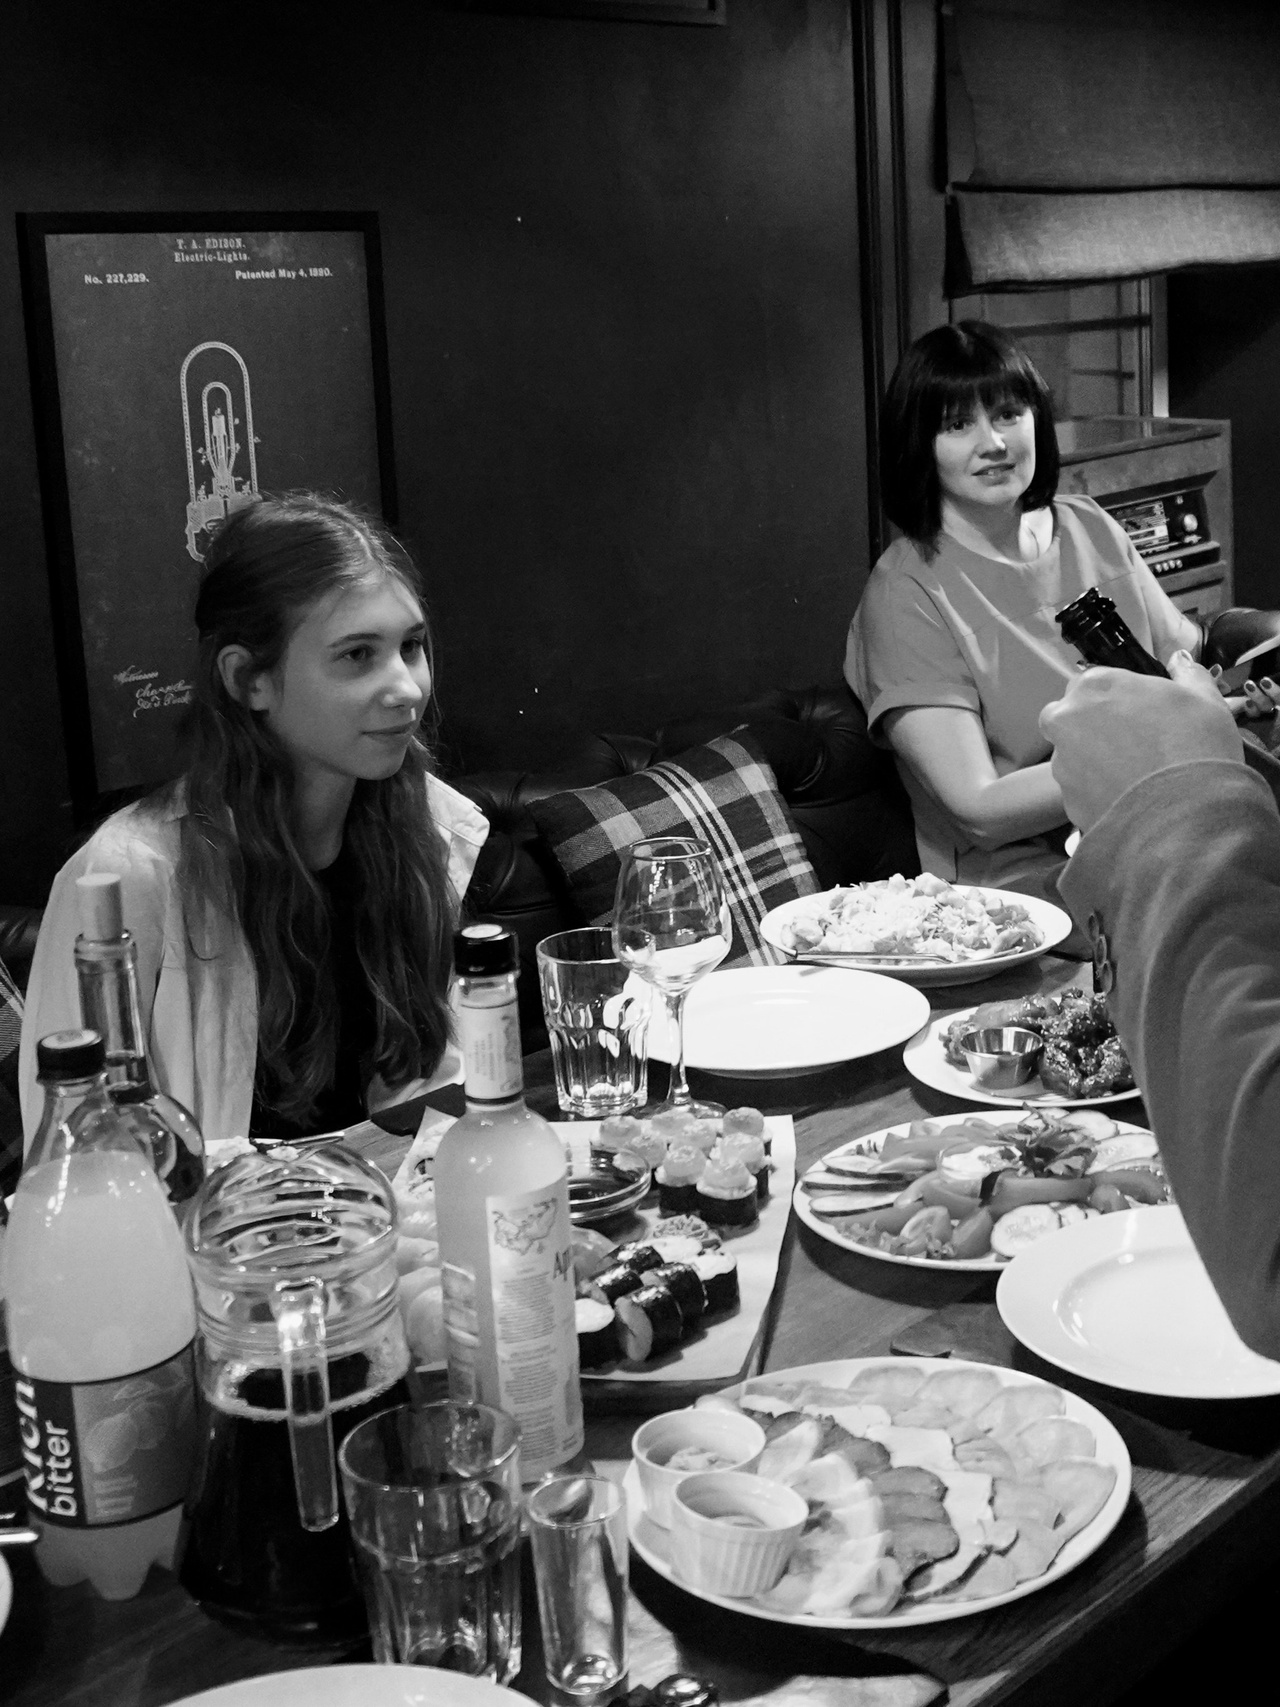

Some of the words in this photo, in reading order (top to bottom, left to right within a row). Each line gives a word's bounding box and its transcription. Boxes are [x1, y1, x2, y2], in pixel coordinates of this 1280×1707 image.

[177, 238, 187, 250] T.
[191, 239, 202, 250] A.
[204, 237, 247, 250] EDISON.
[84, 273, 103, 285] No.
[235, 268, 277, 280] Patented
[278, 267, 297, 280] May
[44, 1419, 78, 1517] bitter
